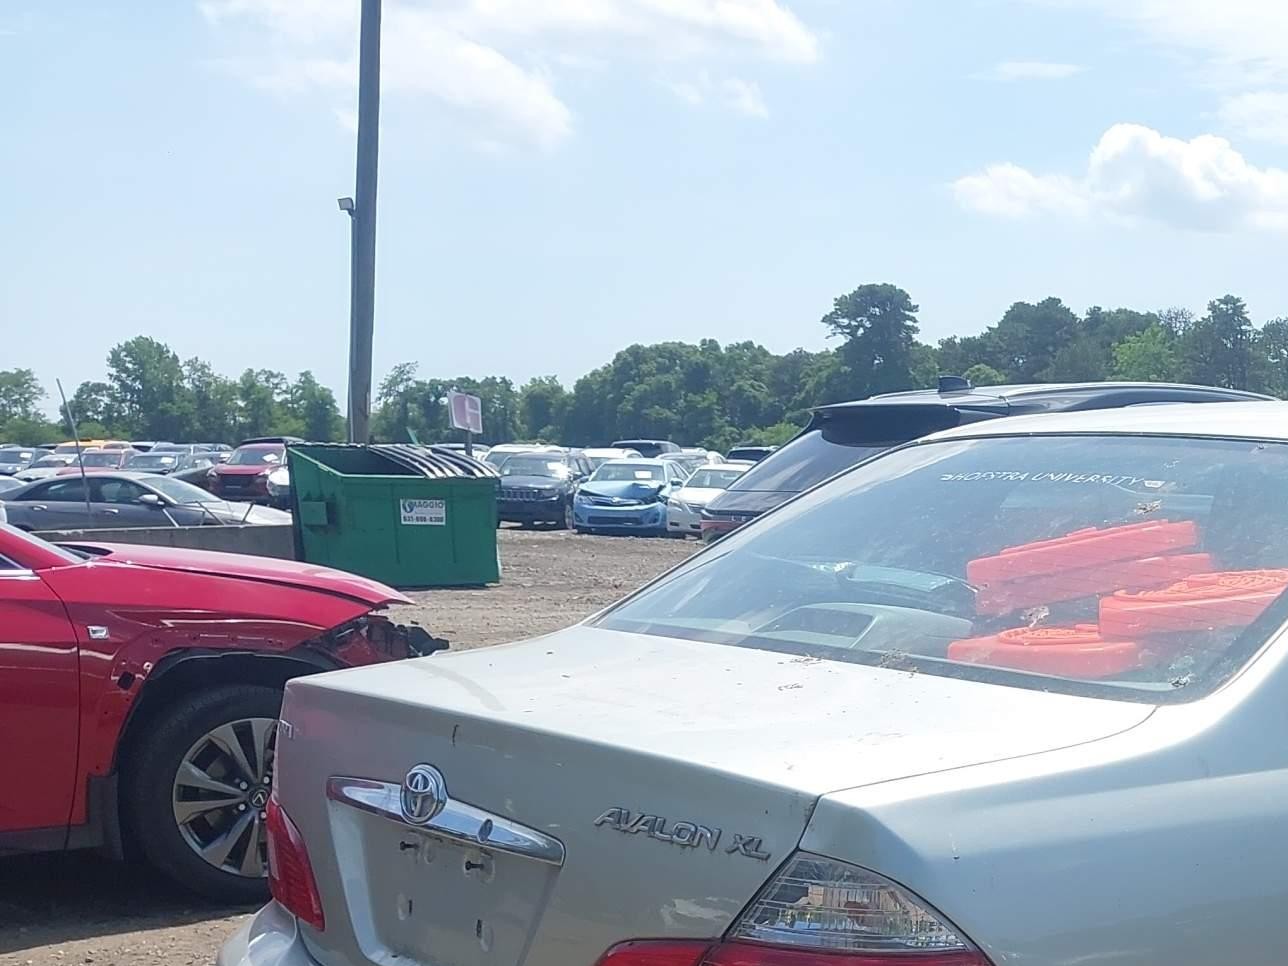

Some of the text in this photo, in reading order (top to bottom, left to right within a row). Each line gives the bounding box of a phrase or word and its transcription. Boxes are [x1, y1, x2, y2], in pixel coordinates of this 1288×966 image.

[1031, 472, 1145, 486] UNIVERSITY
[593, 807, 772, 861] AVALON XL
